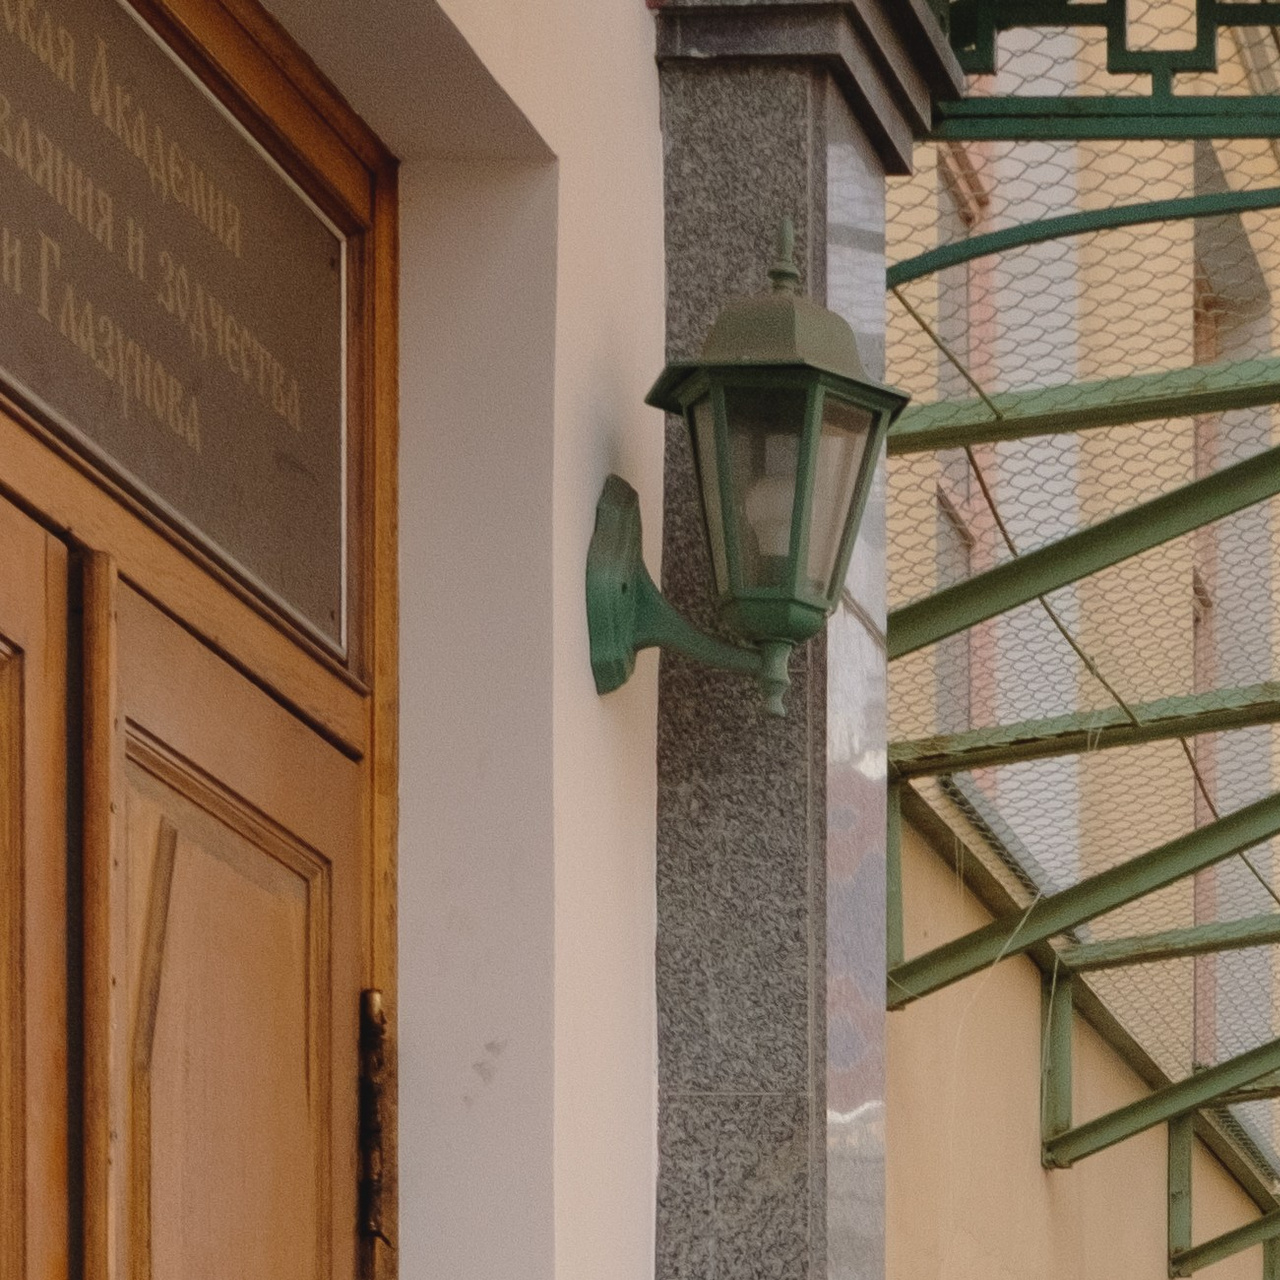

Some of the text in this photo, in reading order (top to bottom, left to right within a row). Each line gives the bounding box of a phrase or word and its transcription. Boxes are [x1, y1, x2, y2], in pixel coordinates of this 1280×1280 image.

[89, 35, 242, 259] Академия
[37, 229, 202, 455] Глазунова
[126, 216, 146, 281] и
[157, 250, 302, 432] зодчества
